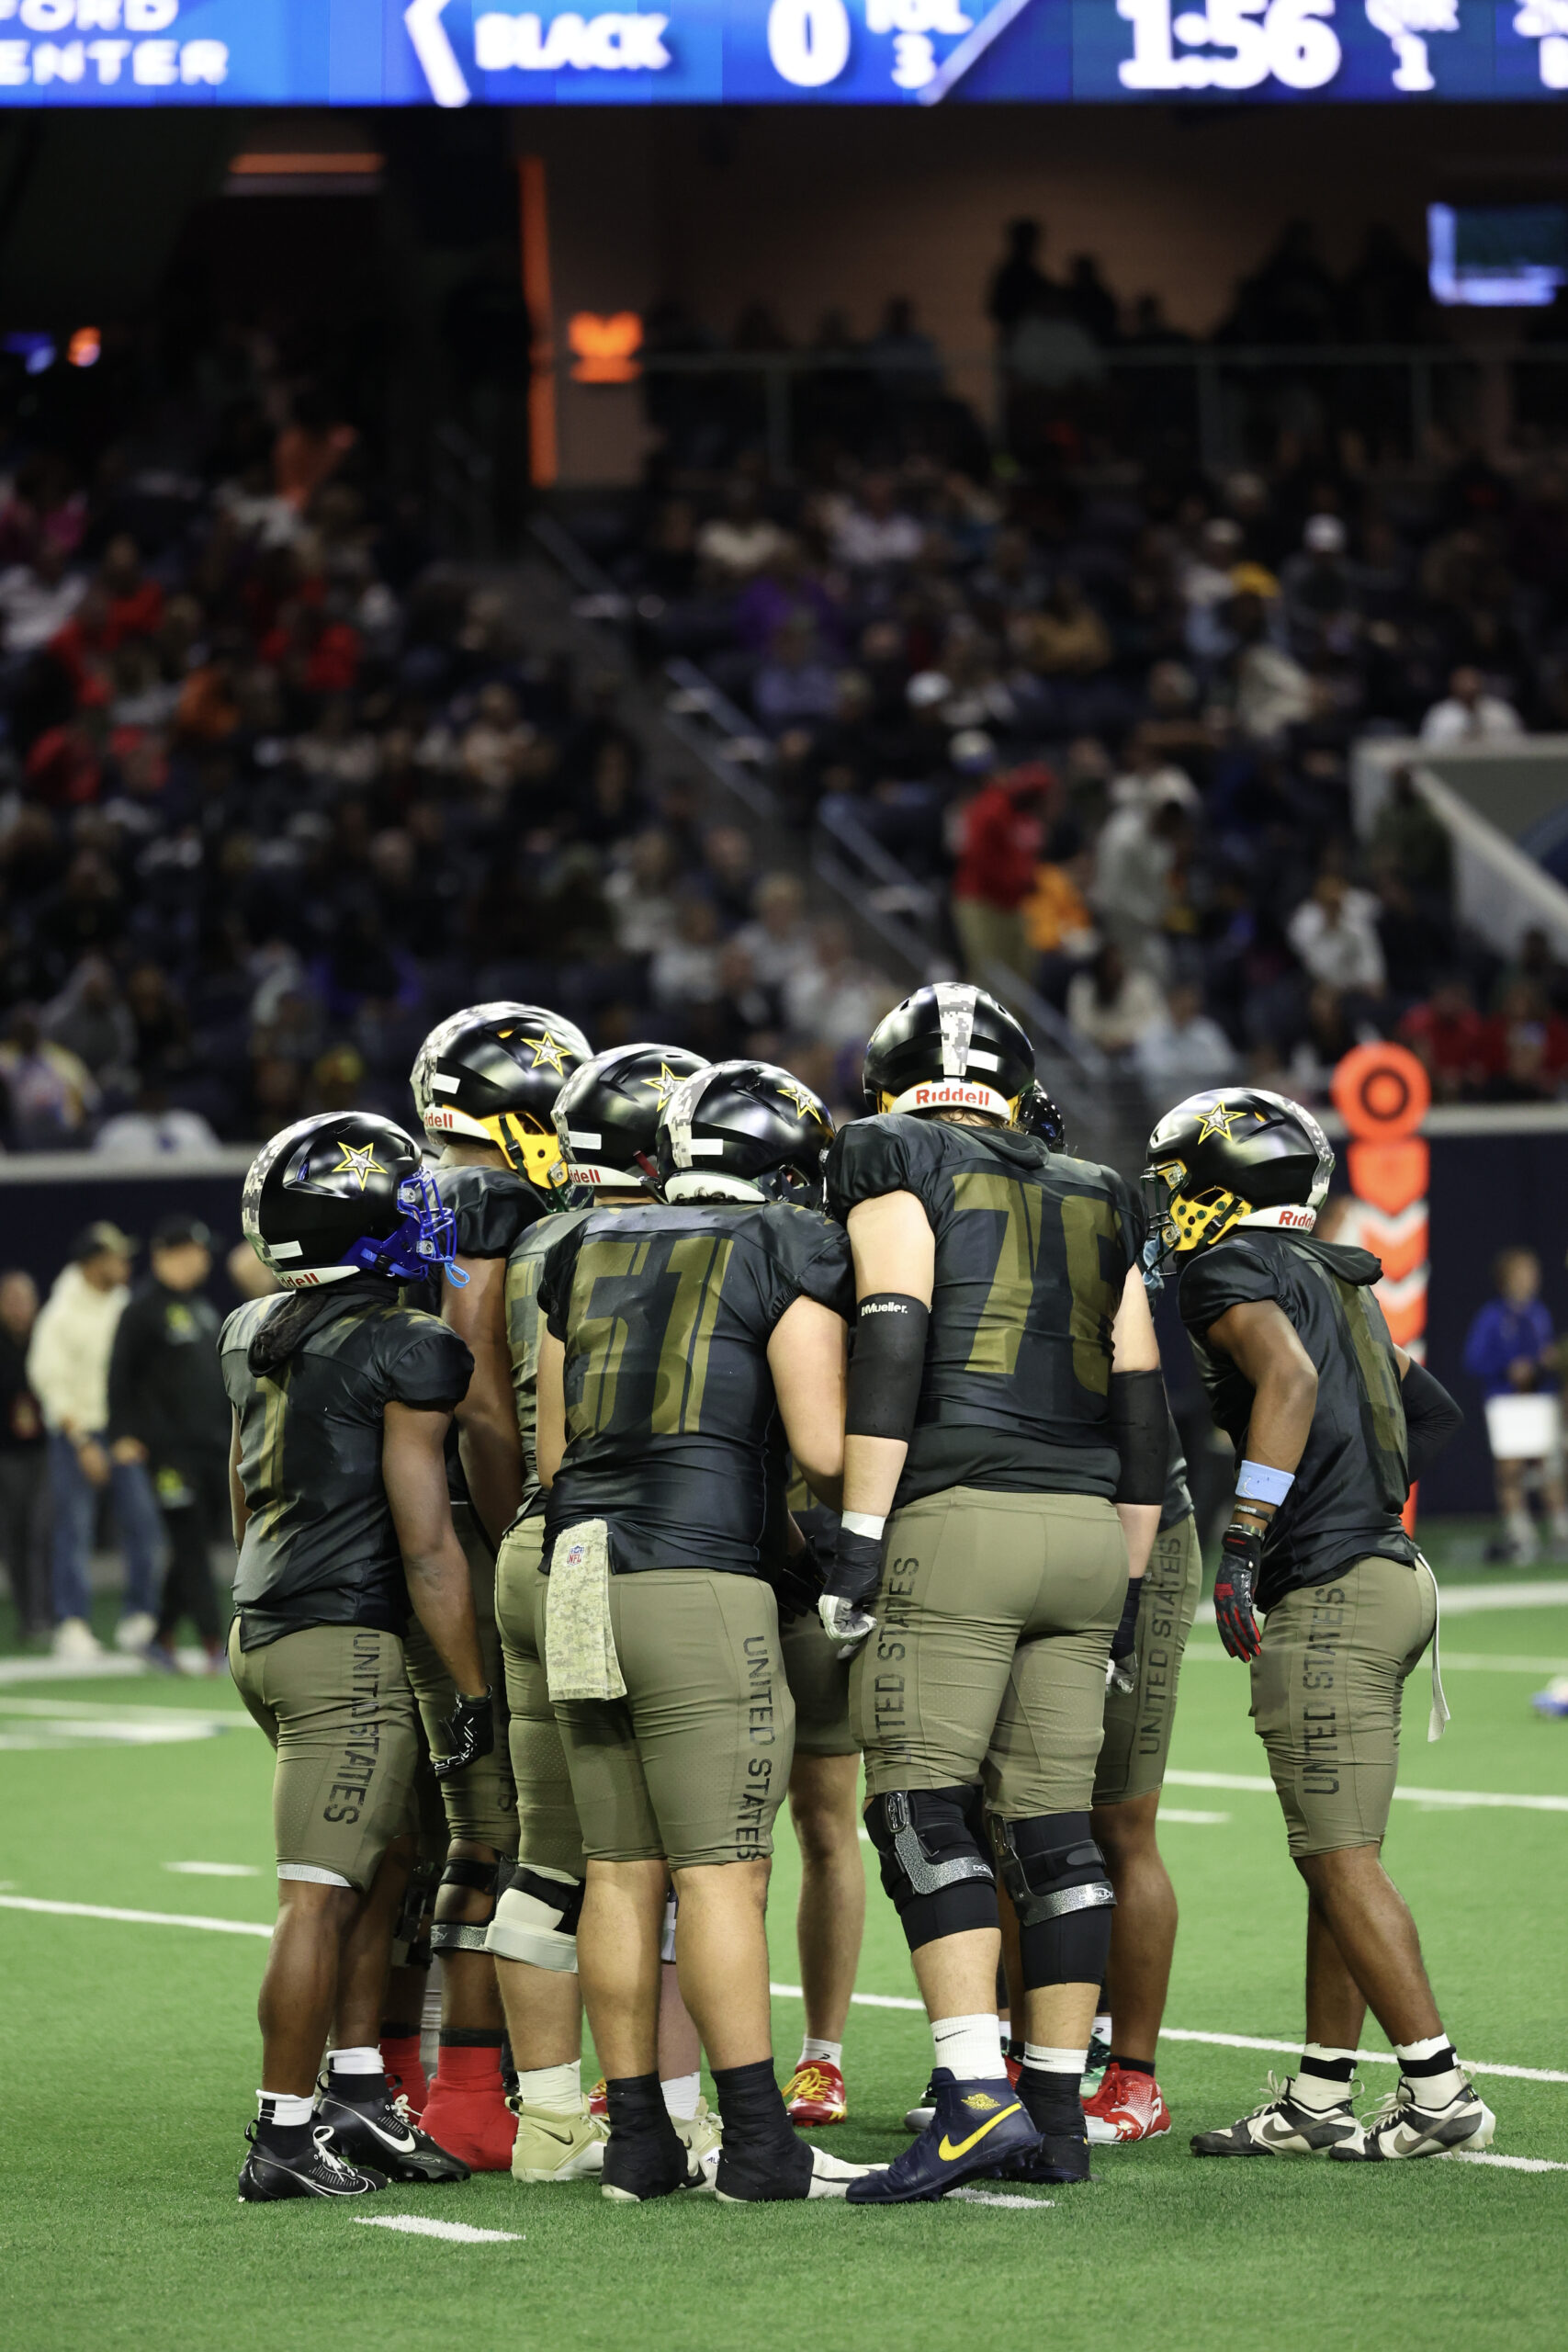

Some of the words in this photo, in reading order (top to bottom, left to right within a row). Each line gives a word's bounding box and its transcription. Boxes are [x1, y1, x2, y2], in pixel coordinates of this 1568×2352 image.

[0, 0, 179, 31] ORD
[474, 12, 672, 71] BLACK
[767, 0, 851, 87] 0
[1116, 0, 1341, 89] 1:56
[891, 33, 937, 89] 3
[916, 1087, 989, 1106] Riddell
[564, 1236, 734, 1440] 51
[1303, 1587, 1346, 1690] STATES
[742, 1635, 776, 1746] UNITED
[1139, 1648, 1168, 1755] UNITED
